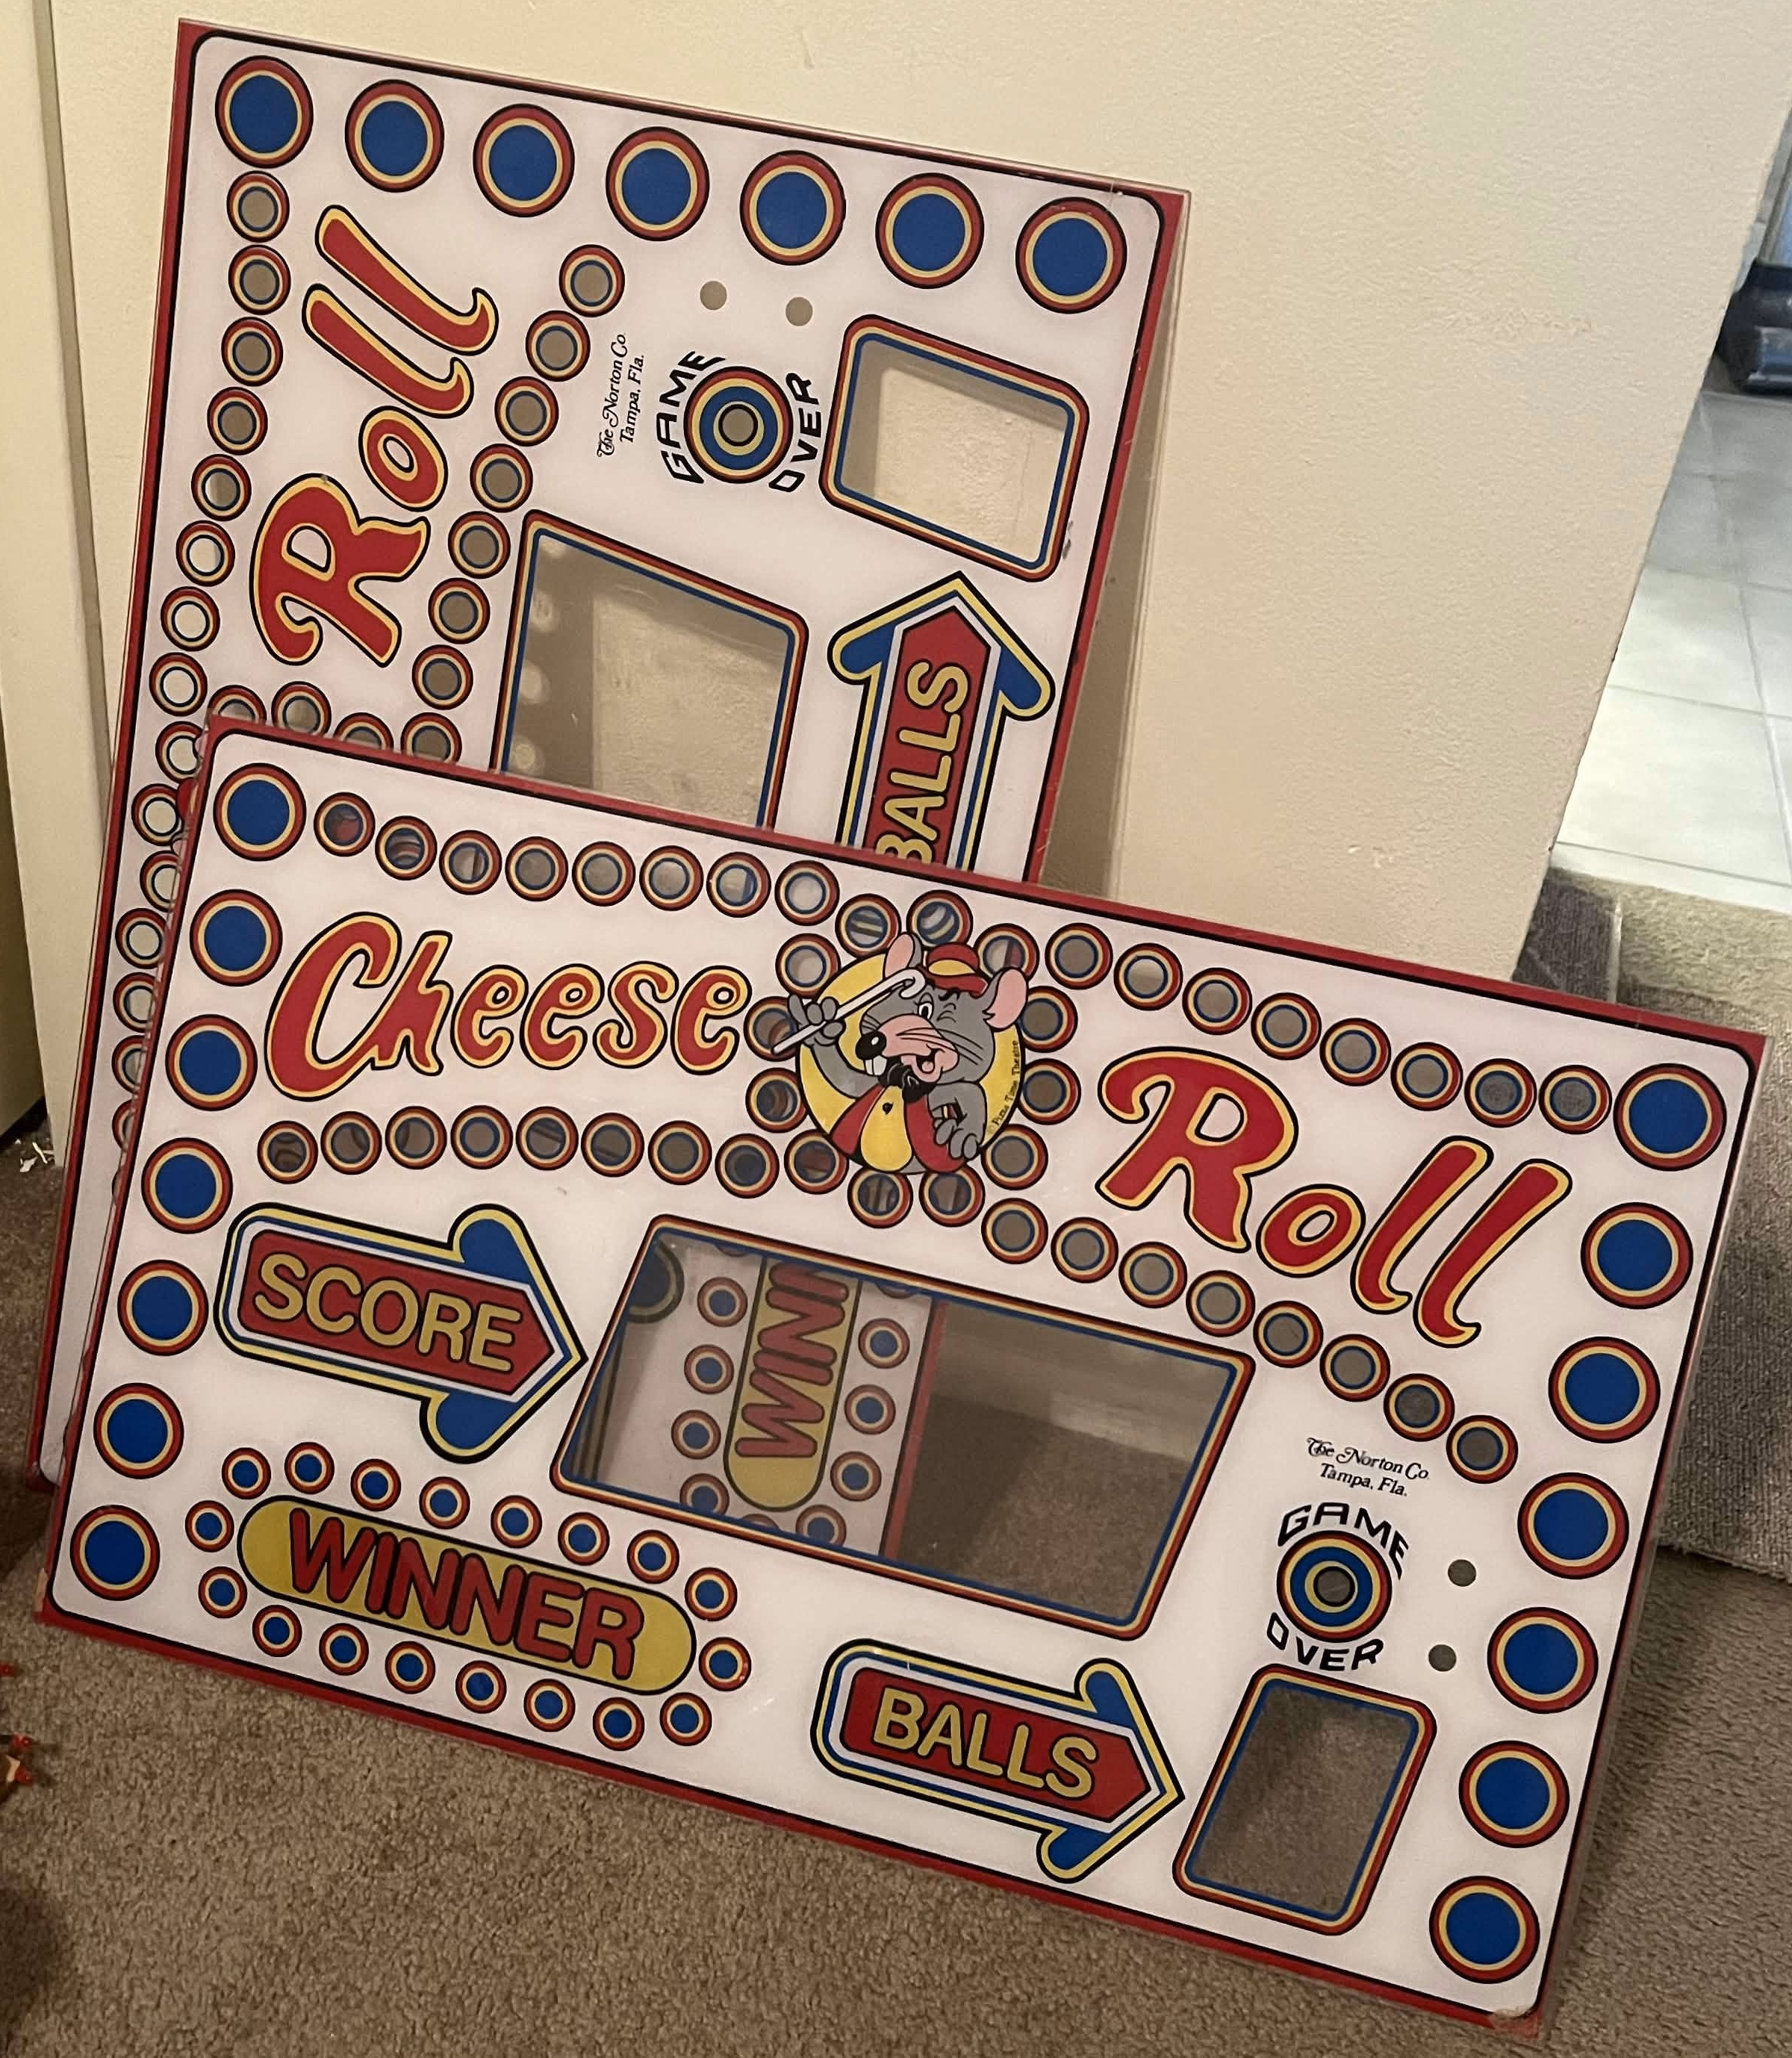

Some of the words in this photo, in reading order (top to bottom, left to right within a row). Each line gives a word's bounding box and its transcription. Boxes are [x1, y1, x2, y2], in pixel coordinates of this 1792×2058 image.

[602, 360, 623, 428] Norton
[627, 355, 644, 385] Fla.
[656, 351, 726, 484] GAME
[249, 205, 499, 668] Roll
[597, 429, 615, 458] The
[768, 373, 821, 493] OVER
[264, 912, 752, 1101] Cheese
[1095, 1046, 1573, 1349] Roll
[252, 1252, 522, 1373] SCORE
[1307, 1437, 1335, 1457] The
[1336, 1446, 1404, 1474] Norton
[1378, 1476, 1407, 1496] Fla.
[289, 1508, 644, 1680] WINNER
[1278, 1502, 1409, 1580] GAME
[1267, 1612, 1384, 1671] OVER
[871, 1686, 1098, 1799] BALLS
